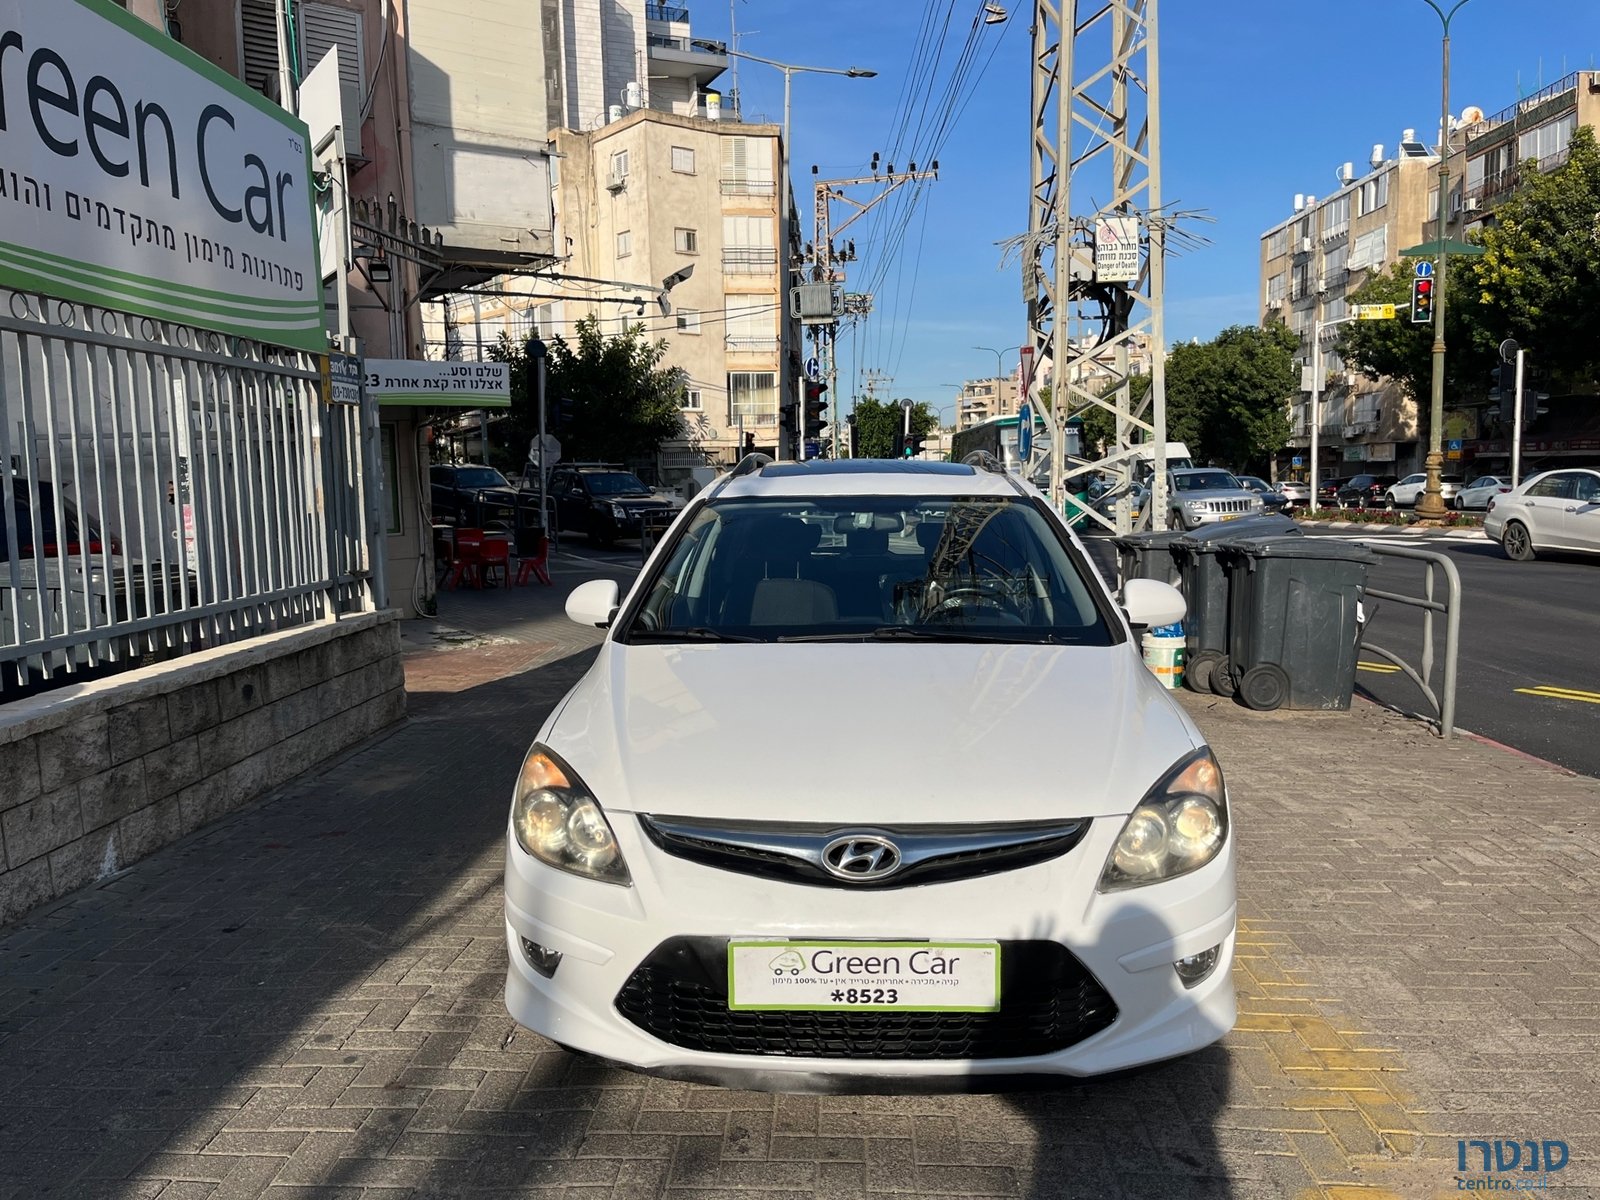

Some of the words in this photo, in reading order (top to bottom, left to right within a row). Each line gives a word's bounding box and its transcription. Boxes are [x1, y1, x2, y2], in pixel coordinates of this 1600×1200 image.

[197, 103, 293, 242] Car
[65, 190, 176, 251] מתקדמים
[184, 231, 235, 268] מימון
[1120, 243, 1137, 251] מתח
[1118, 252, 1137, 260] סכנת
[1097, 262, 1115, 270] Danger
[242, 252, 304, 292] פתרונות
[439, 366, 472, 377] וסע...
[476, 365, 502, 377] שלם
[384, 378, 420, 388] אחרת
[423, 379, 449, 391] קצת
[453, 379, 466, 389] זה
[470, 378, 503, 389] אצלנו
[811, 950, 900, 974] Green
[909, 950, 960, 975] Car
[772, 977, 793, 985] מימון
[835, 978, 847, 986] אין
[941, 978, 959, 986] קניה
